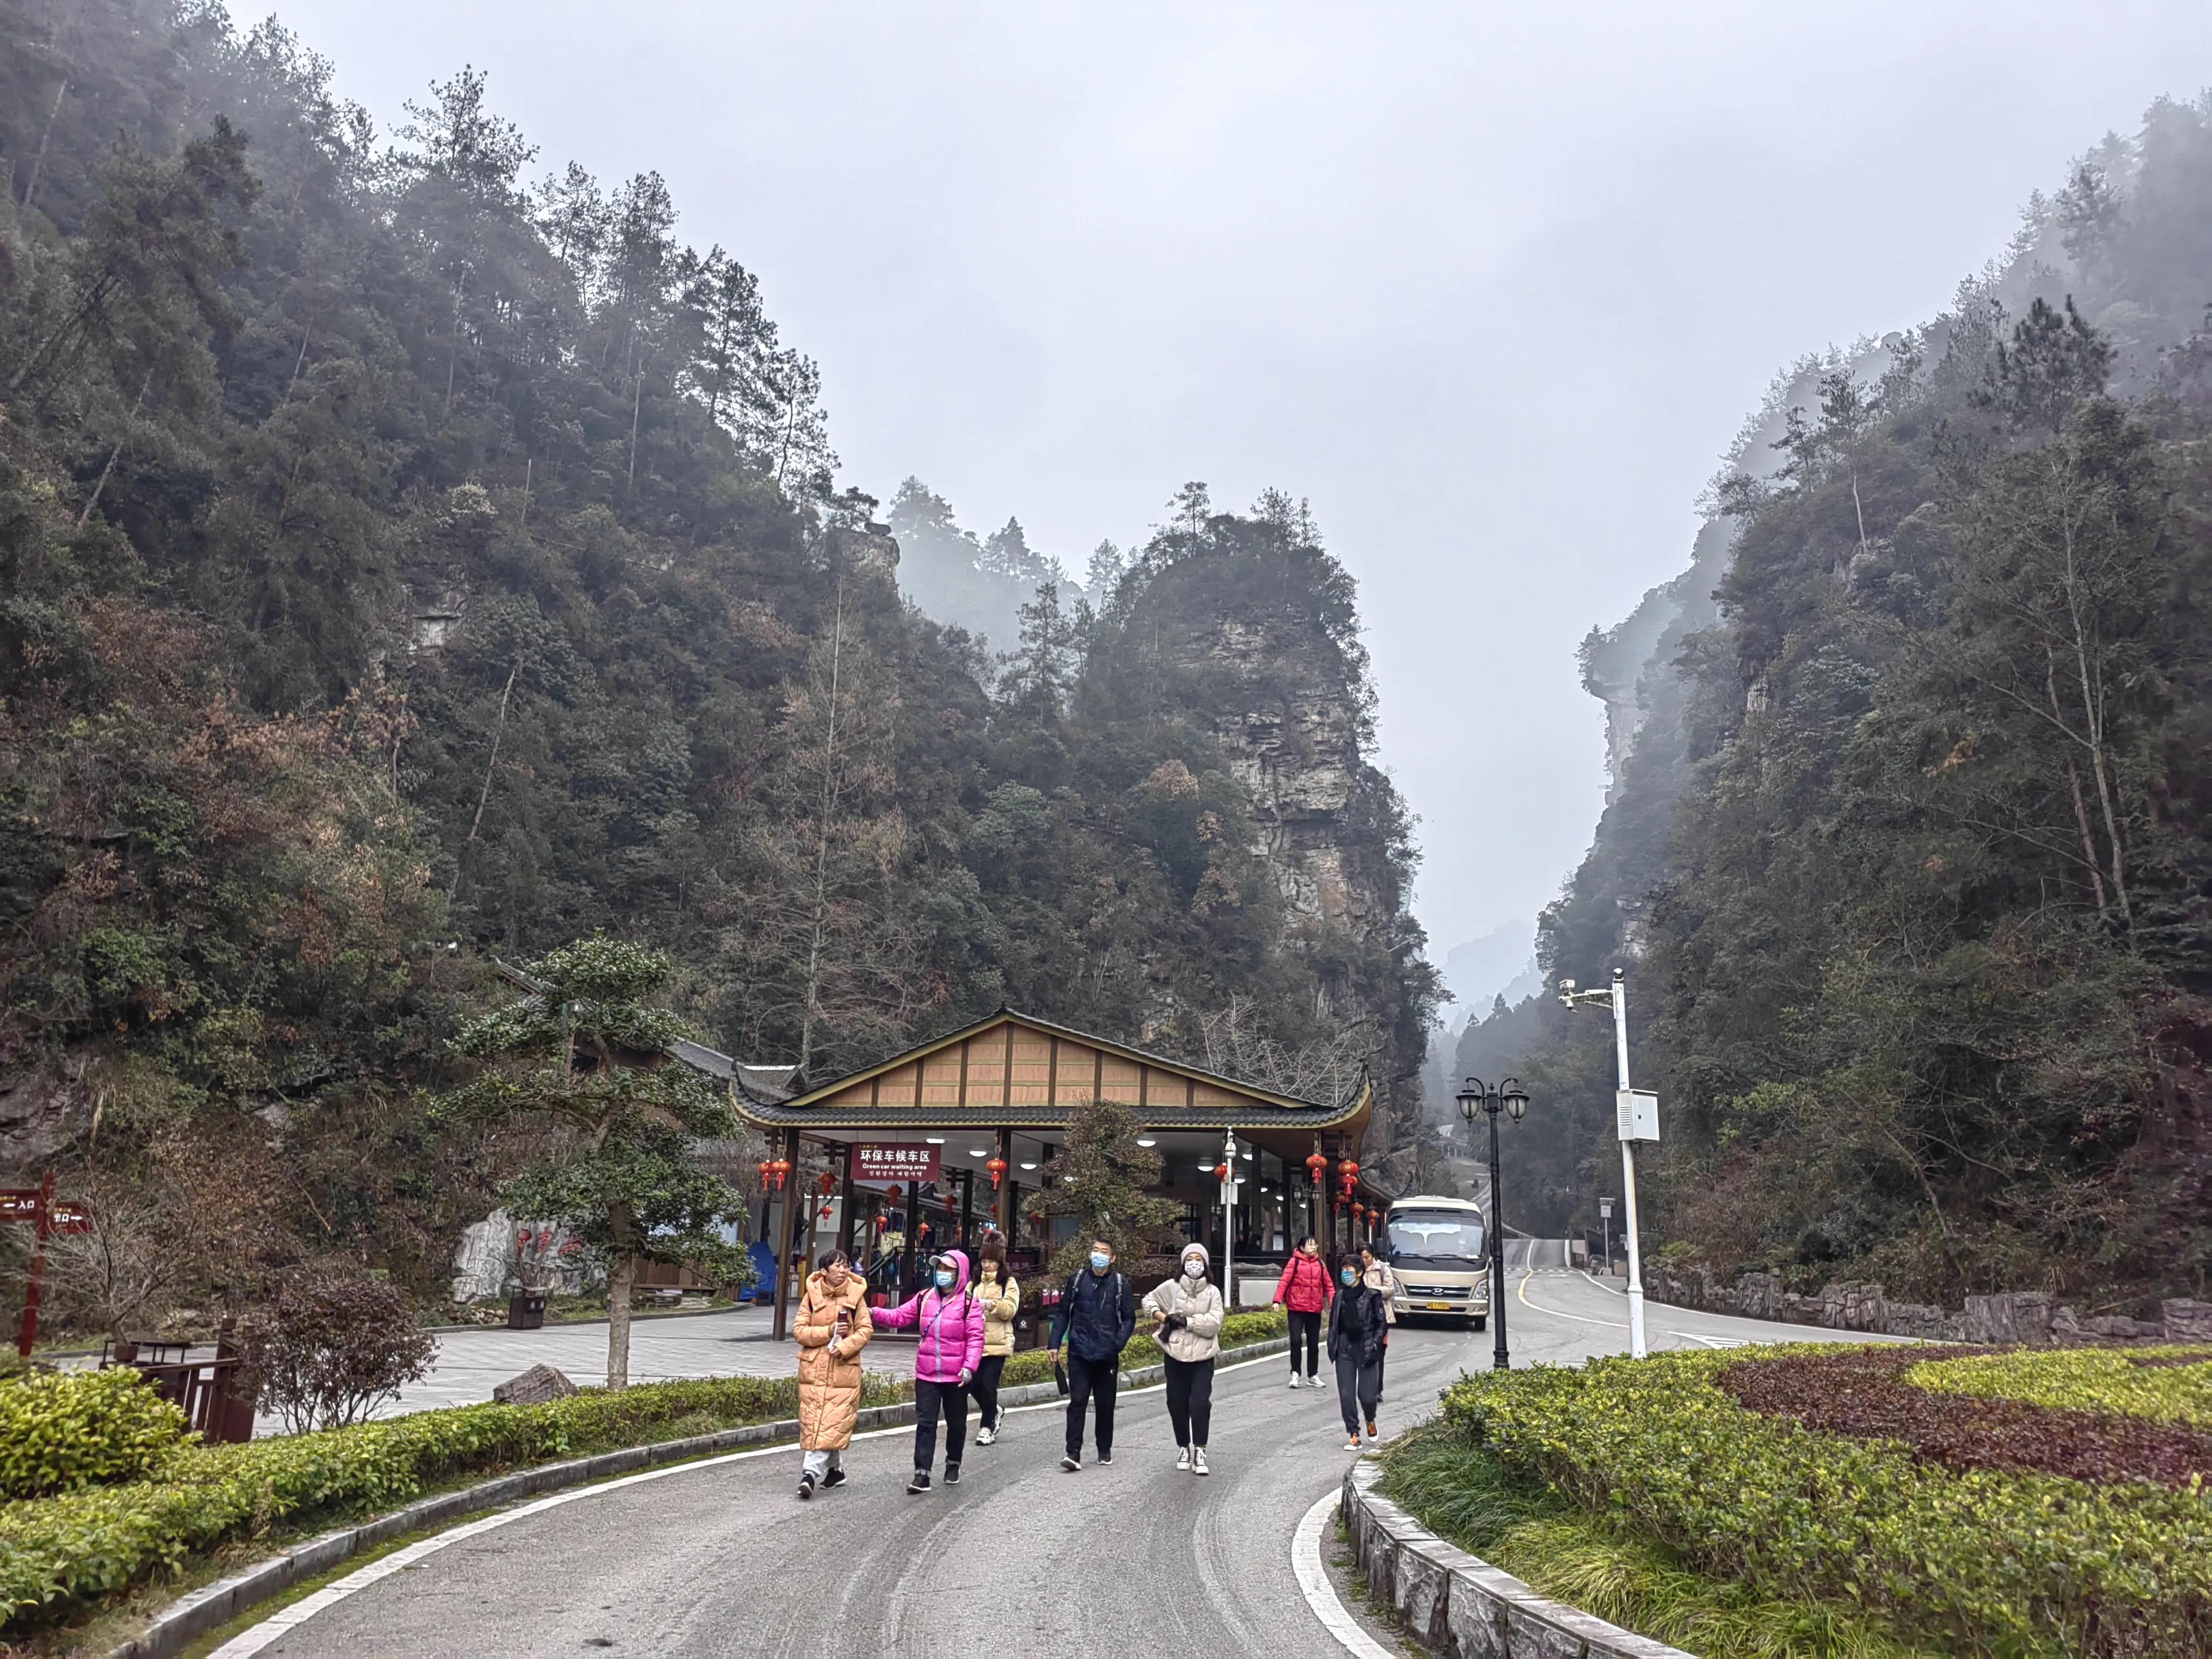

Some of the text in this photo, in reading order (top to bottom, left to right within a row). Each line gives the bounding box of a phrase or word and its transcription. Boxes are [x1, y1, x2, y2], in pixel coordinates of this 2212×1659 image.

[860, 1150, 930, 1162] 环保车候车区
[18, 1200, 35, 1210] 入口
[55, 1213, 69, 1222] 出口
